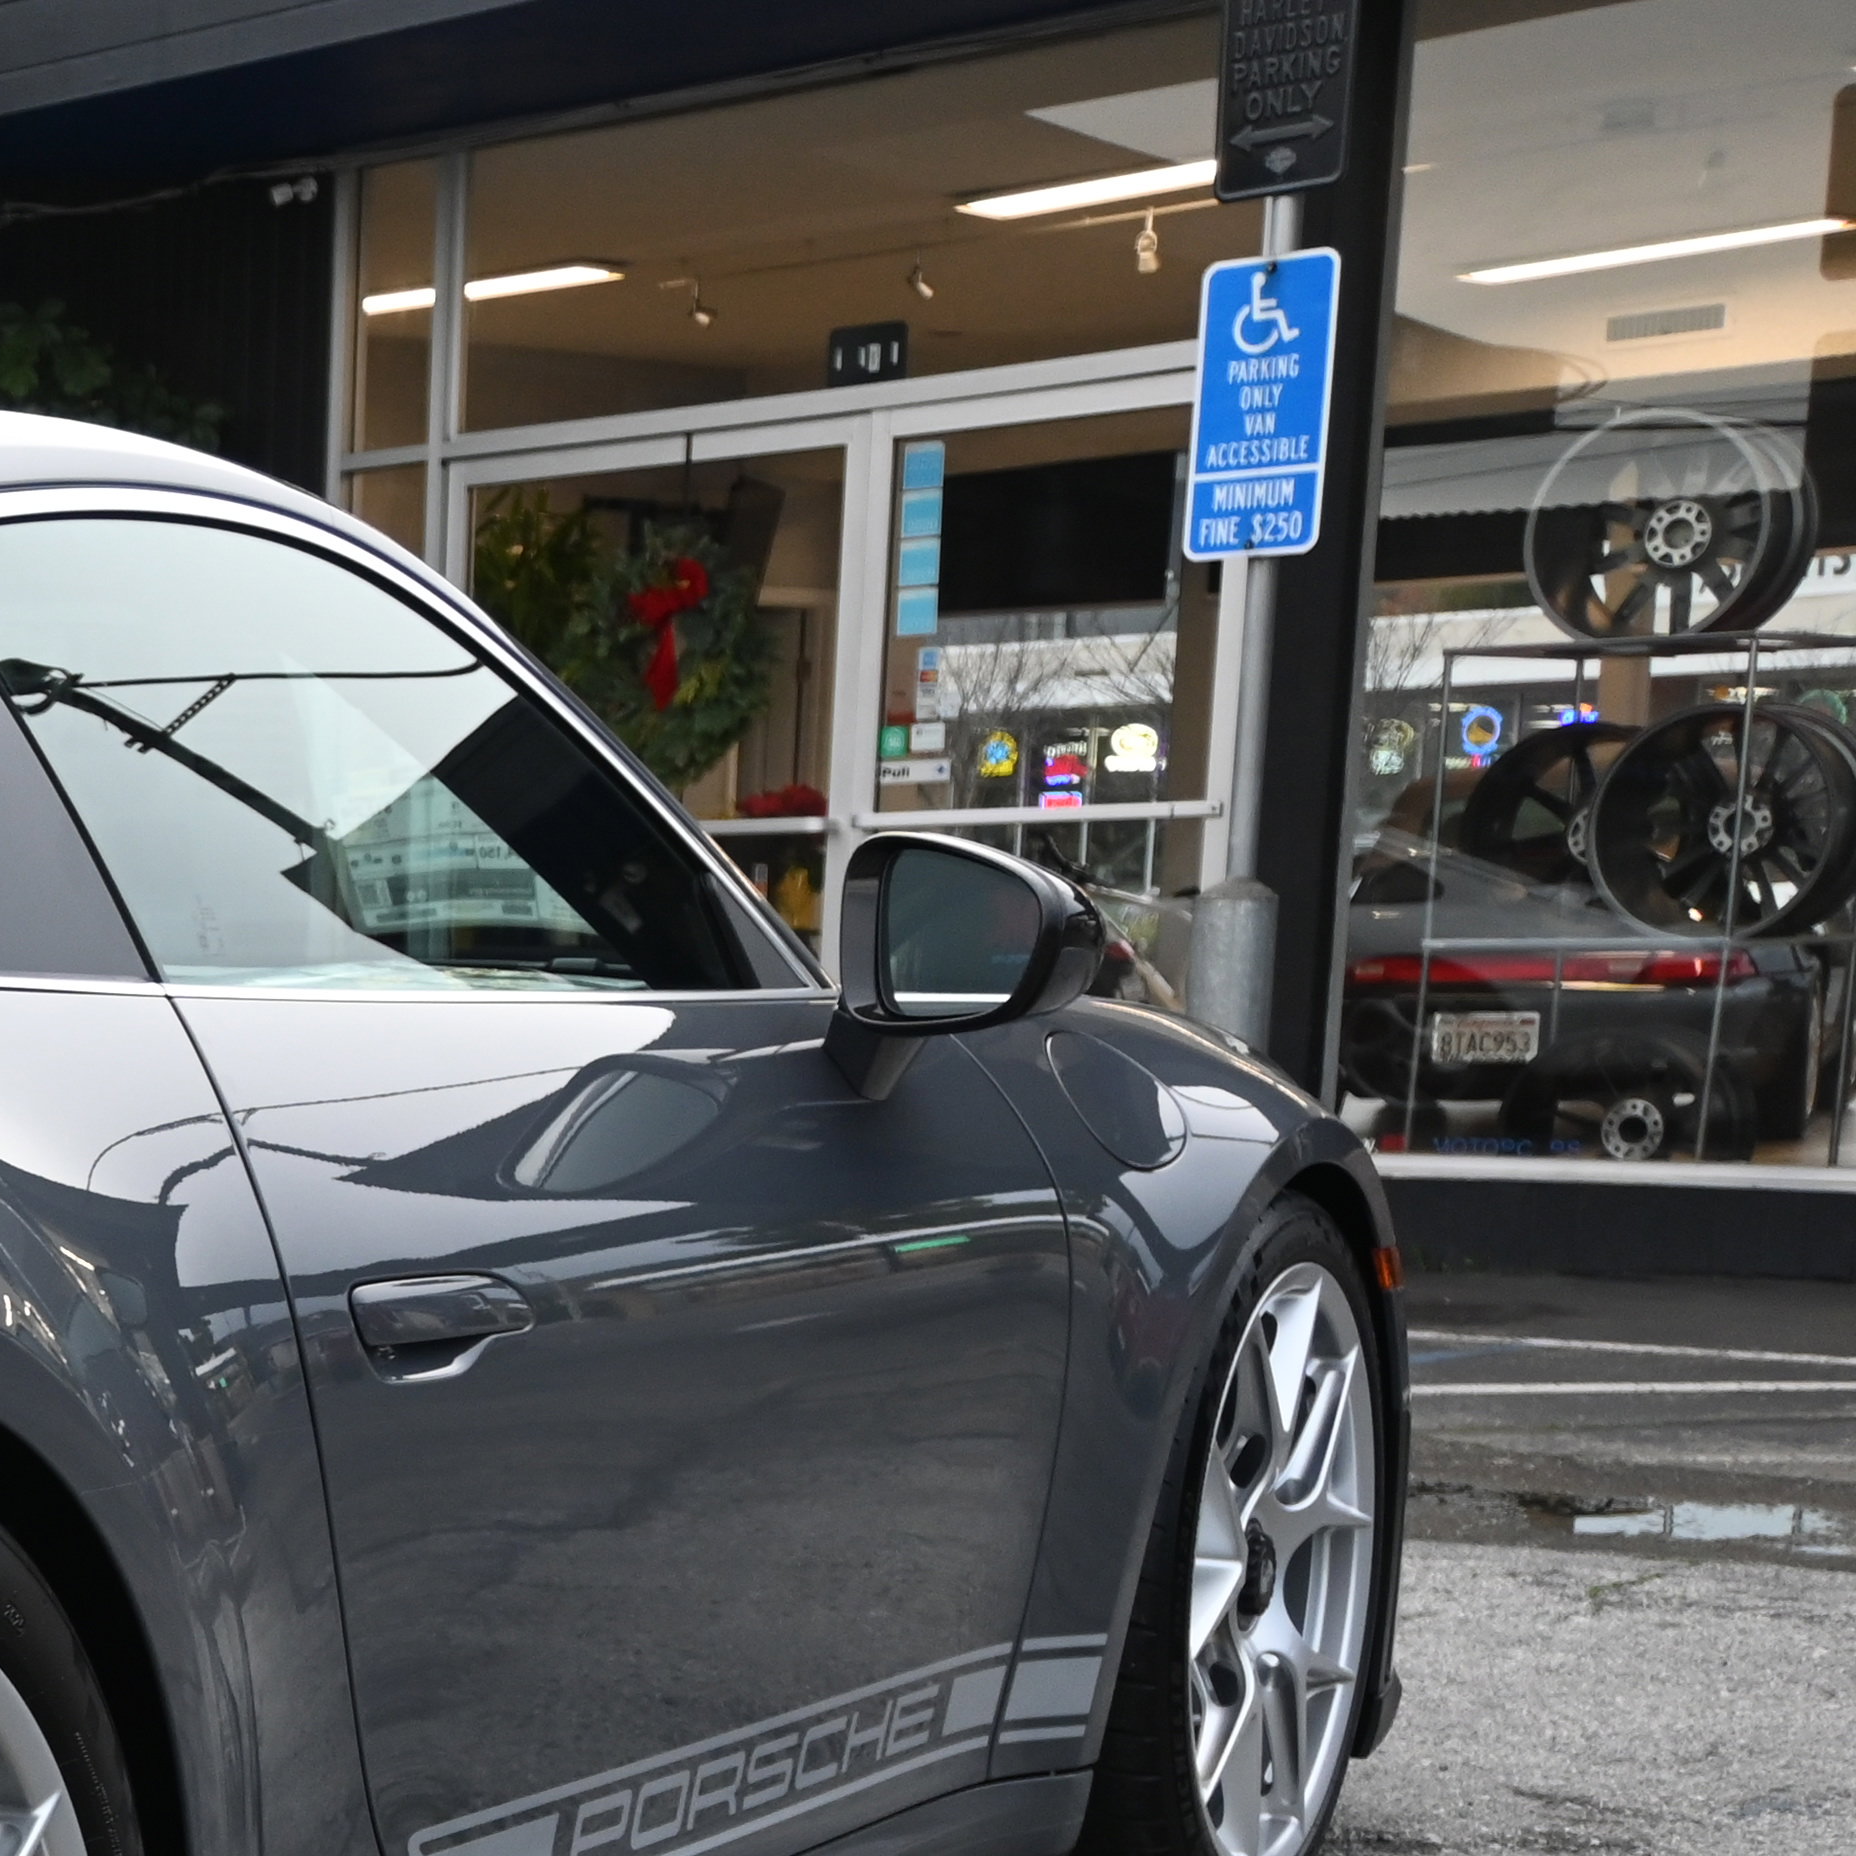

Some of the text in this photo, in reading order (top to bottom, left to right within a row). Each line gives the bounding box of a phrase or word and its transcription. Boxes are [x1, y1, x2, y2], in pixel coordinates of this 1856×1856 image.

[1233, 46, 1341, 91] PARKING
[1245, 80, 1322, 120] ONLY
[1228, 353, 1300, 385] PARKING
[1240, 383, 1283, 411] ONLY
[1244, 412, 1276, 436] VAN
[1206, 435, 1310, 469] ACCESSIBLE
[1213, 478, 1296, 513] MINIMUM
[1200, 510, 1303, 547] FINE $250
